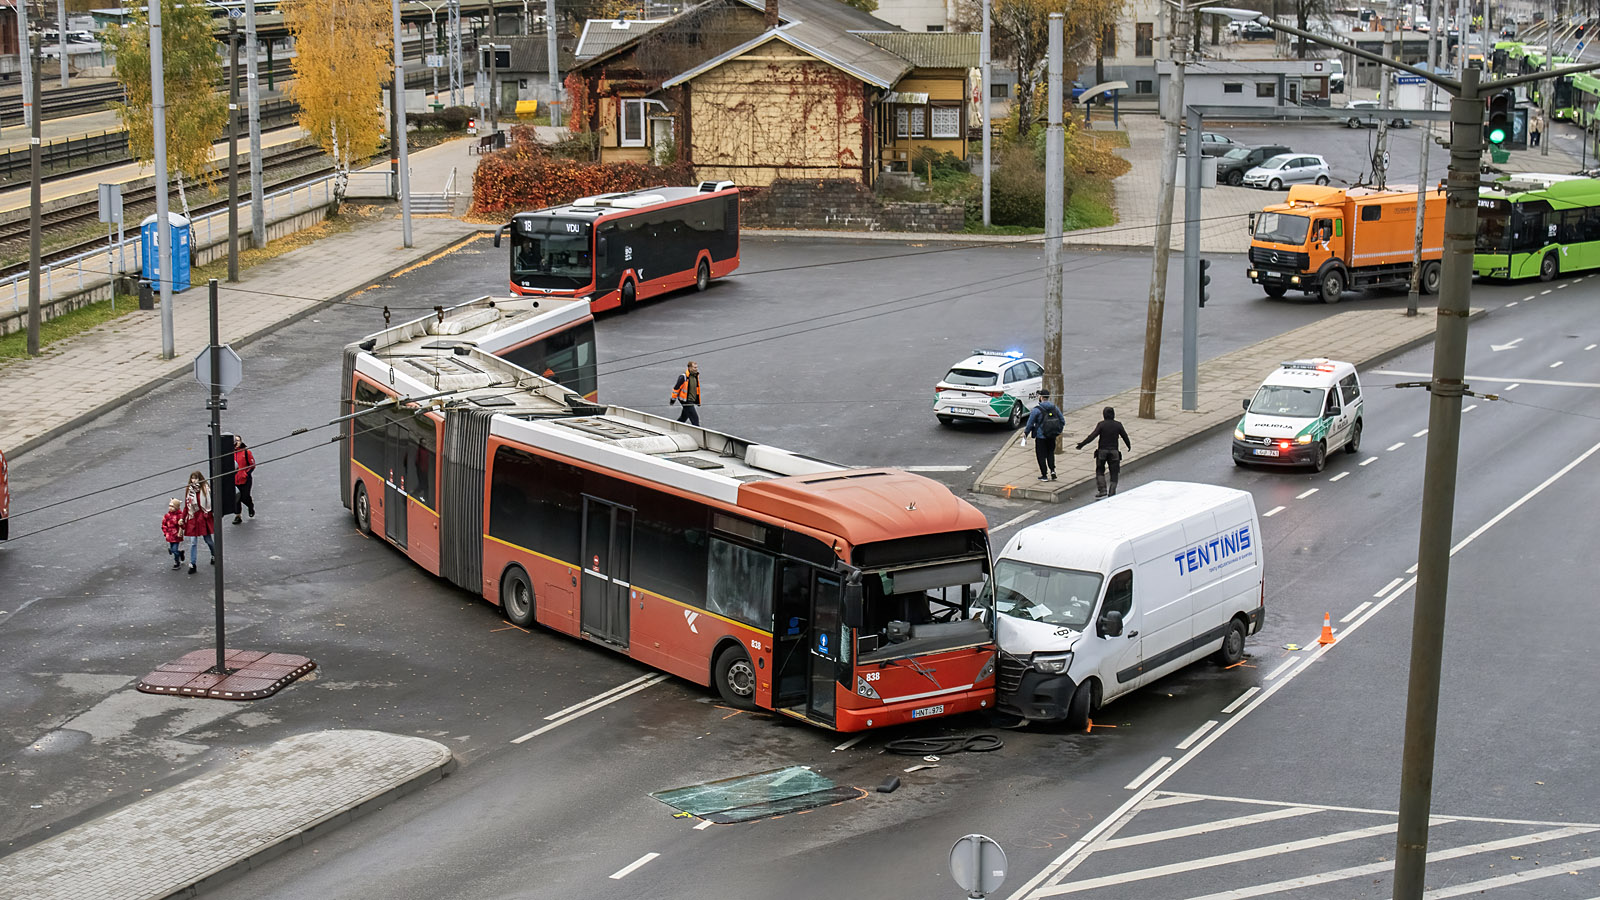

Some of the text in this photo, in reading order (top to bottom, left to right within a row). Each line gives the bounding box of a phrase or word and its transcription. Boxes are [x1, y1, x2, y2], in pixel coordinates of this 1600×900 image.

[524, 220, 580, 233] 18 VDU
[1174, 525, 1251, 577] TENTINIS
[751, 639, 762, 650] 838
[866, 671, 881, 682] 838
[915, 705, 944, 717] HNT 975
